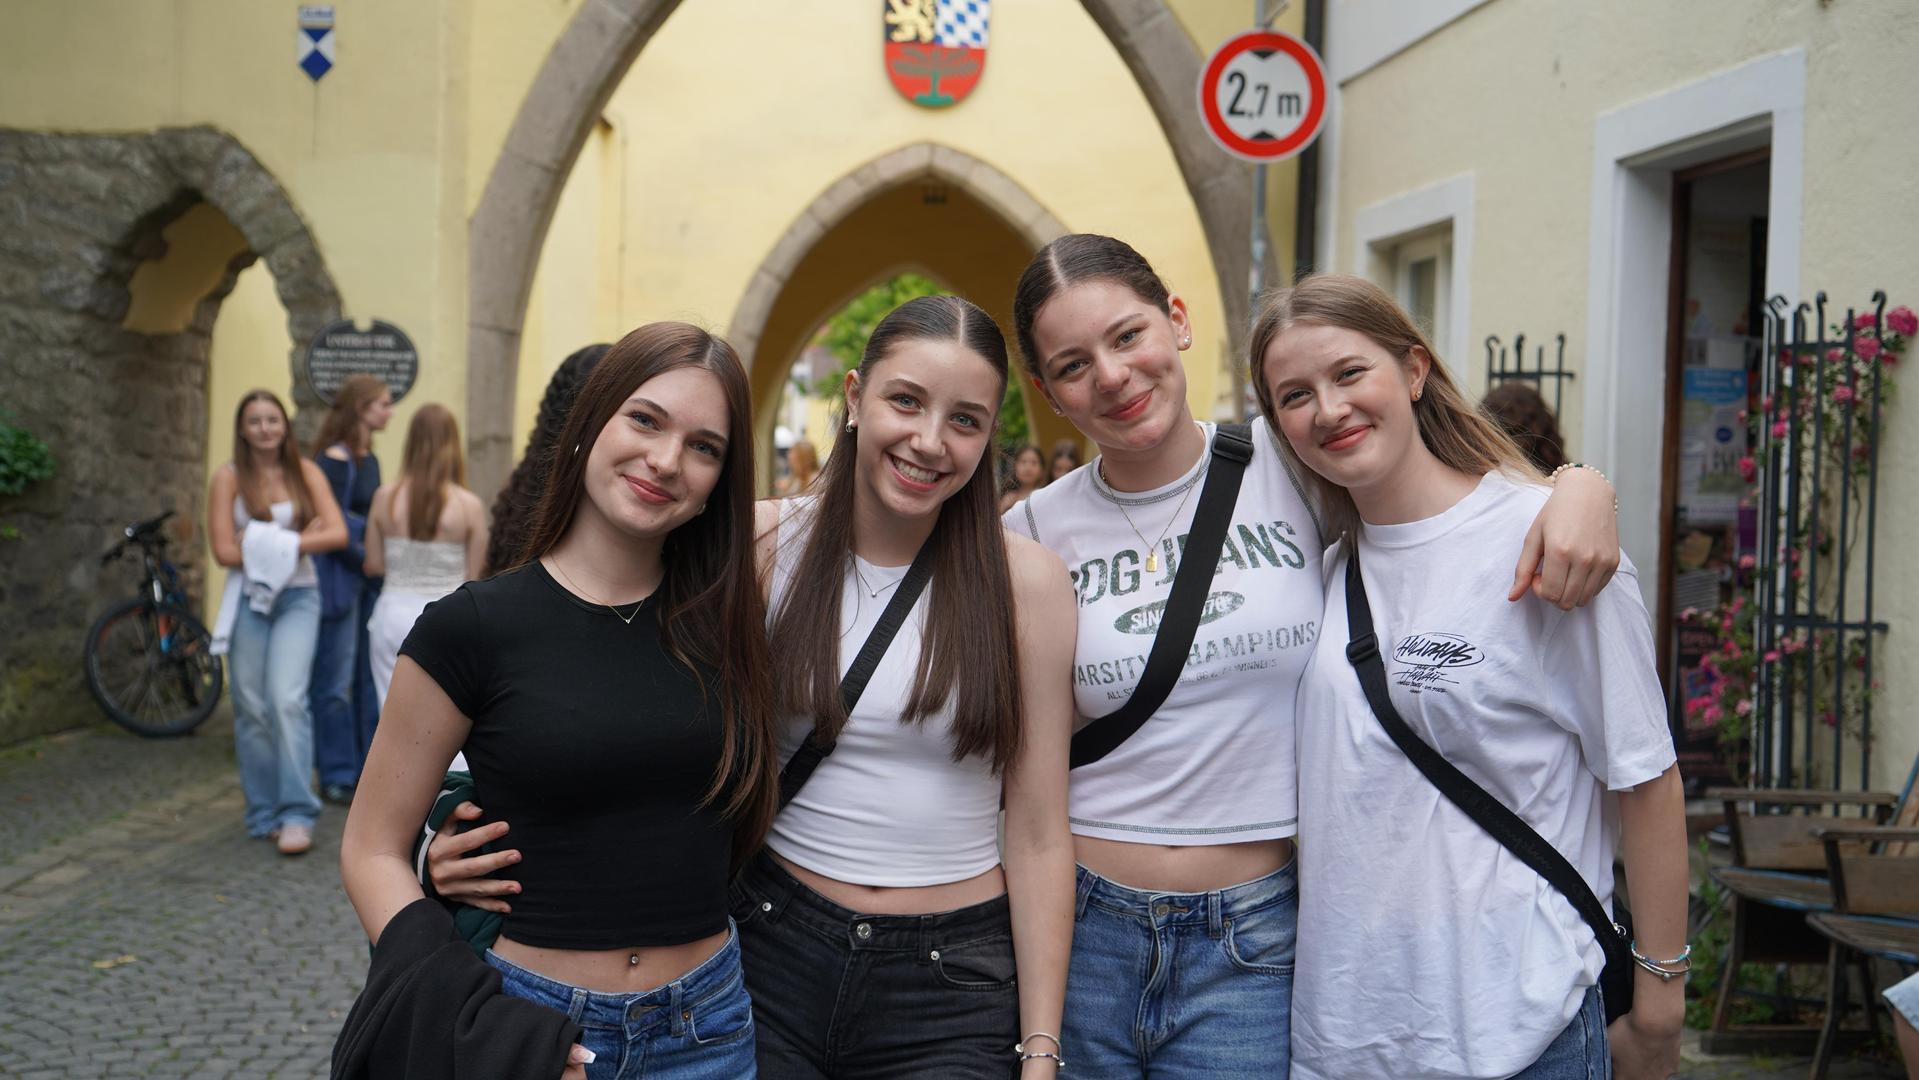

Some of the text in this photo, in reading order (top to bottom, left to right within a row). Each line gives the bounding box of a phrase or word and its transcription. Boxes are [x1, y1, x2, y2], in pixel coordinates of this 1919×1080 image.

[1277, 92, 1302, 117] m
[1070, 520, 1306, 609] DG JANS
[1130, 608, 1166, 629] SIN
[1186, 621, 1315, 667] HAMPIONS
